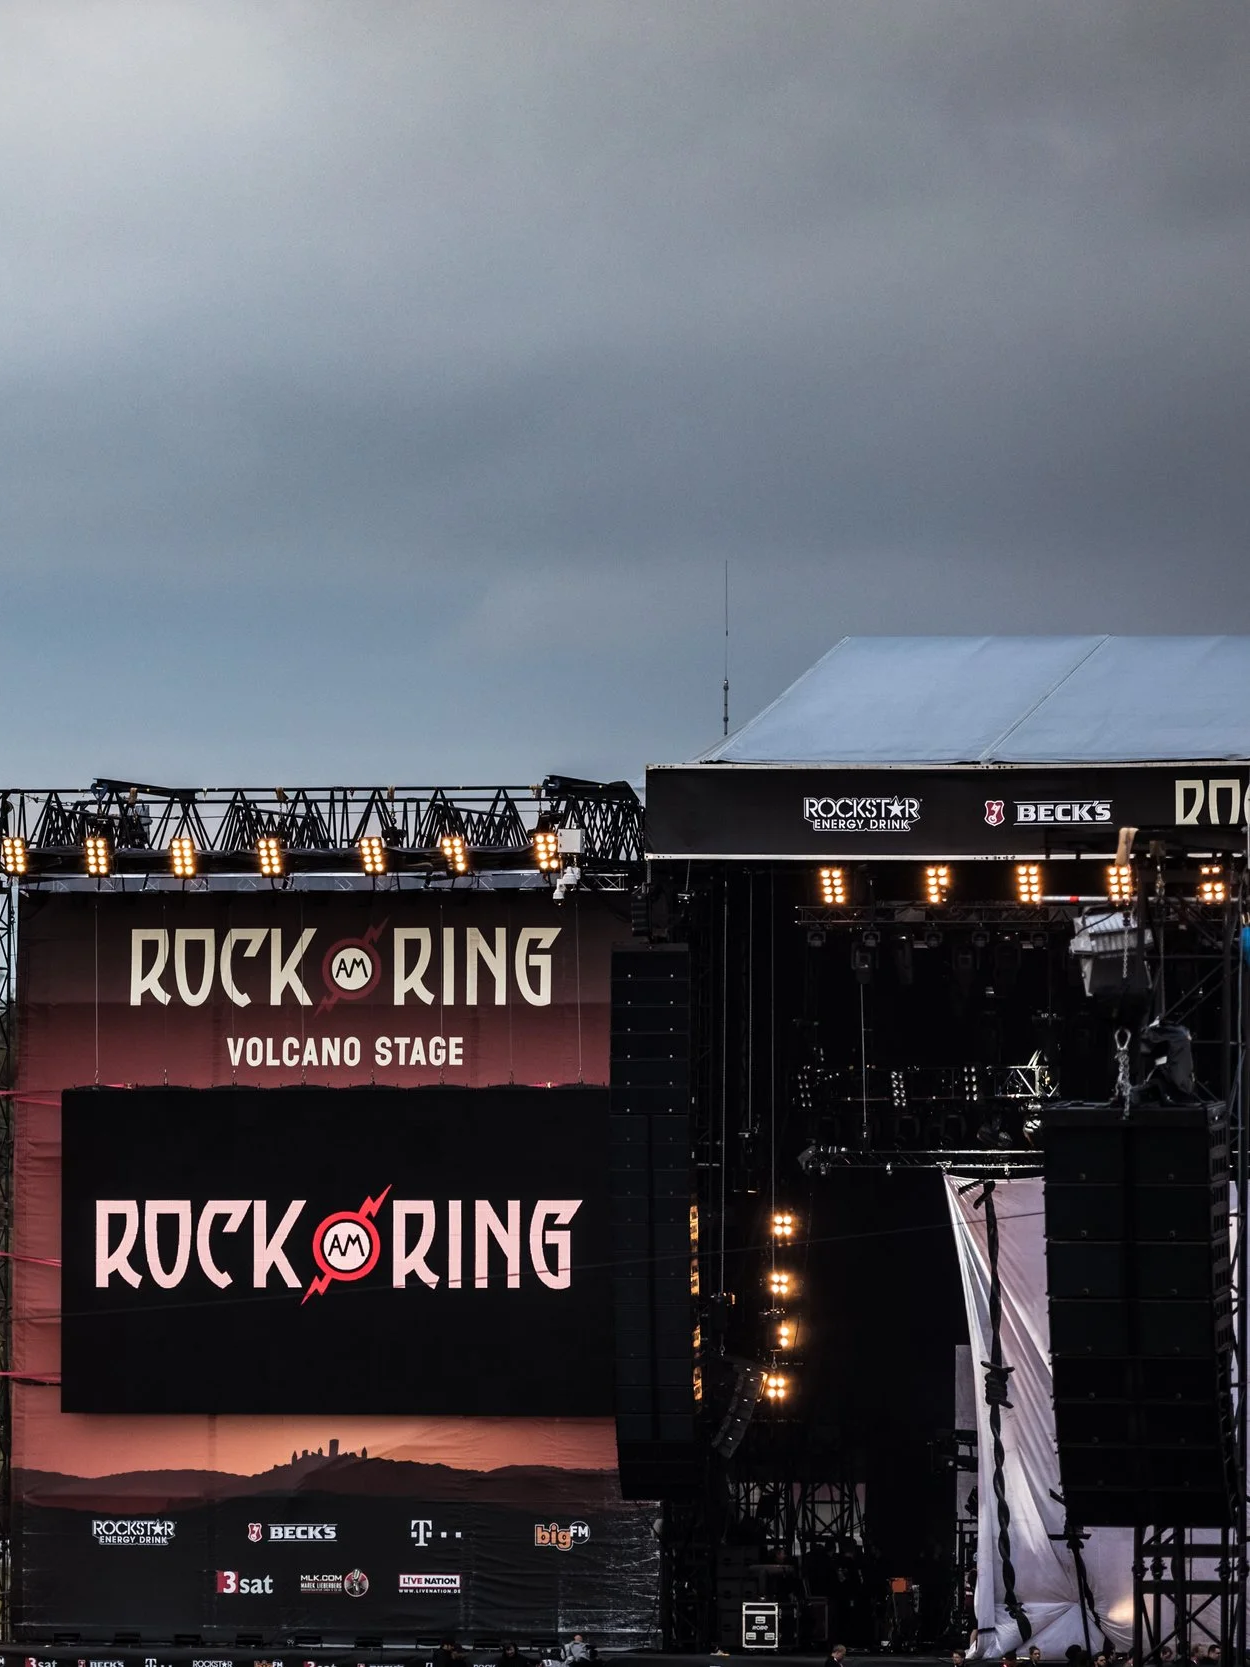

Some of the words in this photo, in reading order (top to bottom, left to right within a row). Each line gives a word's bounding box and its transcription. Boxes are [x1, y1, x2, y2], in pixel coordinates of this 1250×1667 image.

[805, 797, 919, 818] ROCKSTAR
[1017, 802, 1111, 821] BECK'S
[814, 819, 864, 830] ENERGY
[869, 819, 910, 830] DRINK
[130, 928, 317, 1008] ROCK
[335, 956, 369, 979] AM
[393, 927, 562, 1007] RING
[226, 1037, 361, 1067] VOLCANO
[374, 1037, 464, 1066] STAGE
[95, 1200, 307, 1289] ROCK
[327, 1233, 366, 1257] AM
[392, 1200, 584, 1290] RING
[93, 1519, 175, 1536] ROCKSTAR
[270, 1525, 337, 1540] BECK'S
[100, 1536, 135, 1544] ENERGY
[139, 1536, 168, 1544] DRINK
[223, 1571, 274, 1594] 3sat
[424, 1577, 457, 1585] NATION
